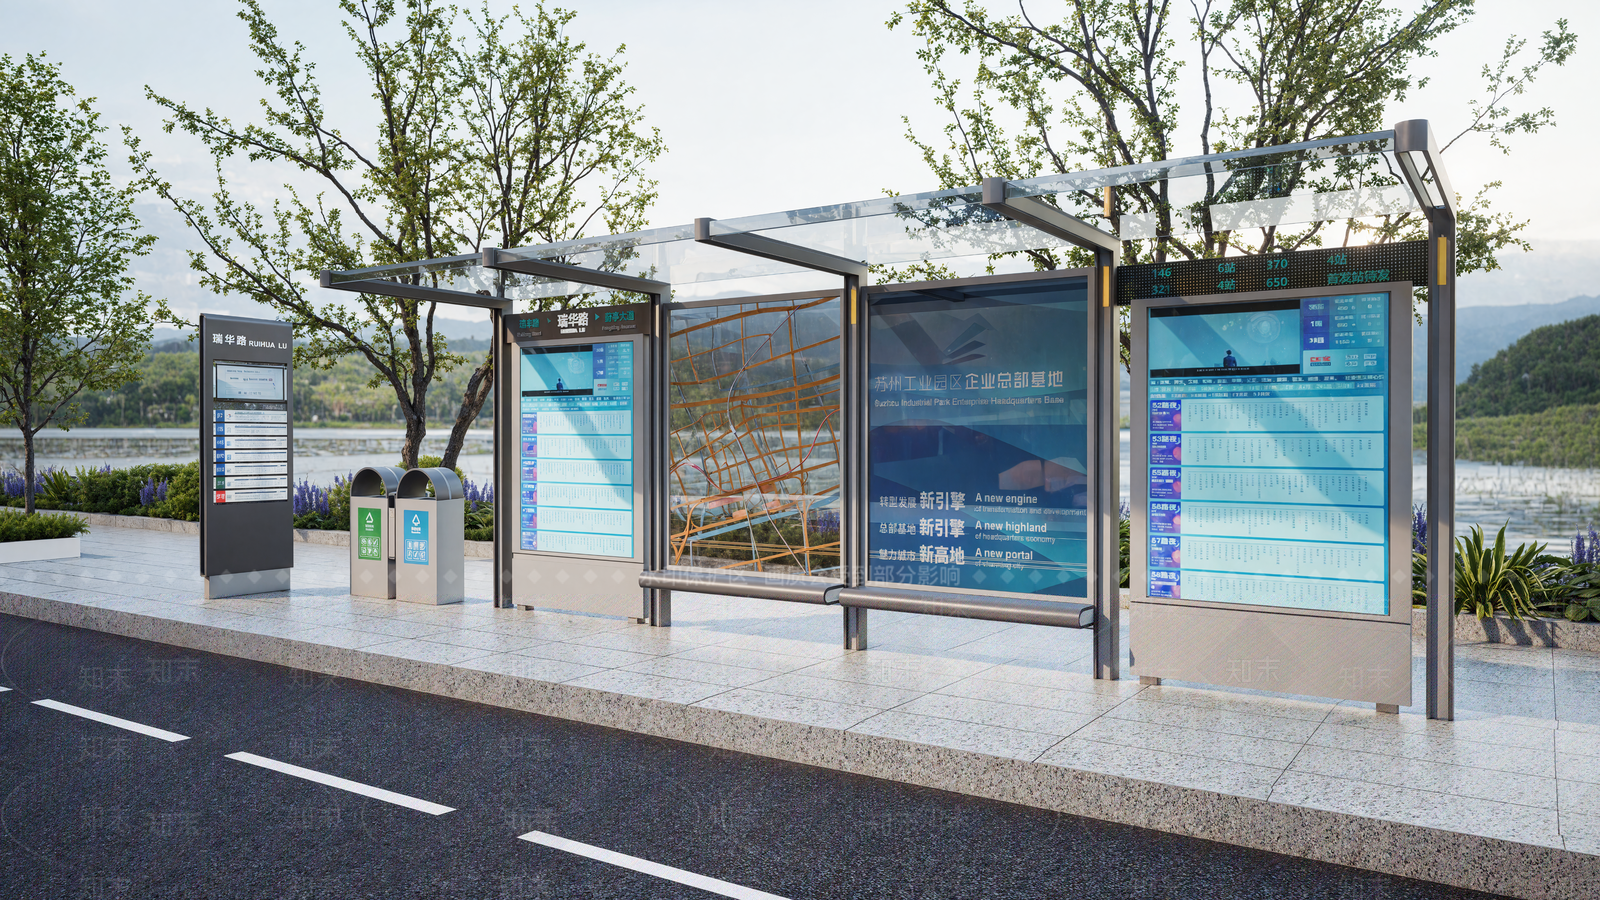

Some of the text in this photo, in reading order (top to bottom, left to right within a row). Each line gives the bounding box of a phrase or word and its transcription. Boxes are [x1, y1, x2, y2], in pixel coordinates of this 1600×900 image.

[1266, 258, 1288, 270] 370
[1326, 252, 1348, 266] 4站
[1152, 267, 1172, 279] 146
[1217, 262, 1236, 274] 6站
[1217, 278, 1236, 290] 4站
[1266, 276, 1288, 288] 650
[1152, 284, 1170, 295] 321
[557, 311, 589, 328] 瑞华路
[212, 333, 288, 350] 瑞华路 RUIHUA LU
[901, 397, 933, 407] Industrial
[933, 397, 951, 406] Park
[1044, 395, 1065, 404] Base
[879, 490, 966, 511] 转型发展 新引擎
[975, 492, 1038, 506] A new engine
[879, 517, 966, 538] 总部基地 新引擎
[975, 520, 1048, 534] A new highland
[919, 544, 966, 566] 新高地
[975, 547, 1033, 561] A new portal
